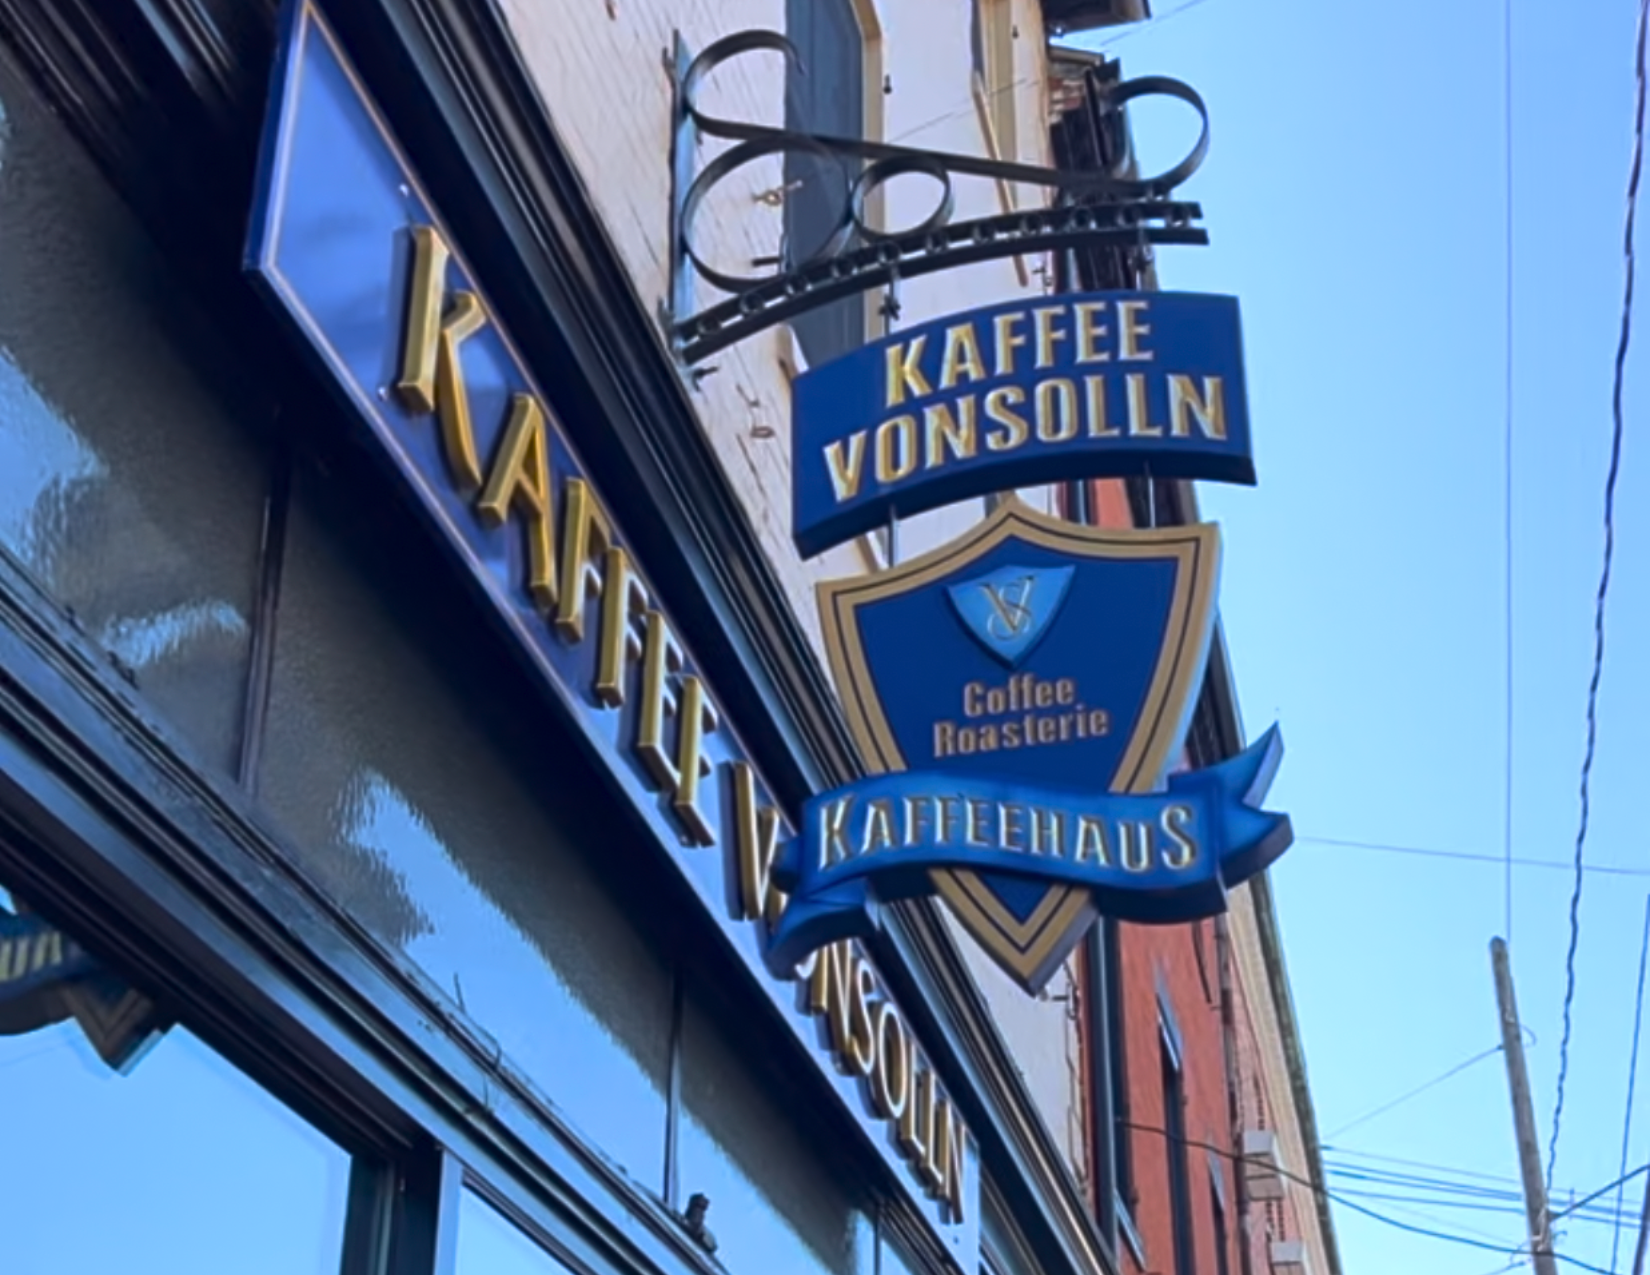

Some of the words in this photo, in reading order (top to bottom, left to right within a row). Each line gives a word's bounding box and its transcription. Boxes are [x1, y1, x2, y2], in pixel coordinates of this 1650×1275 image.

[885, 300, 1154, 408] KAFFEE
[822, 373, 1228, 502] VONSOLLN
[398, 225, 715, 847] KAFFEE
[734, 761, 968, 1224] VNSOLLN
[933, 703, 1109, 758] Roasterie
[963, 673, 1075, 718] Coffee
[818, 793, 1198, 872] KAFFEEHAUS
